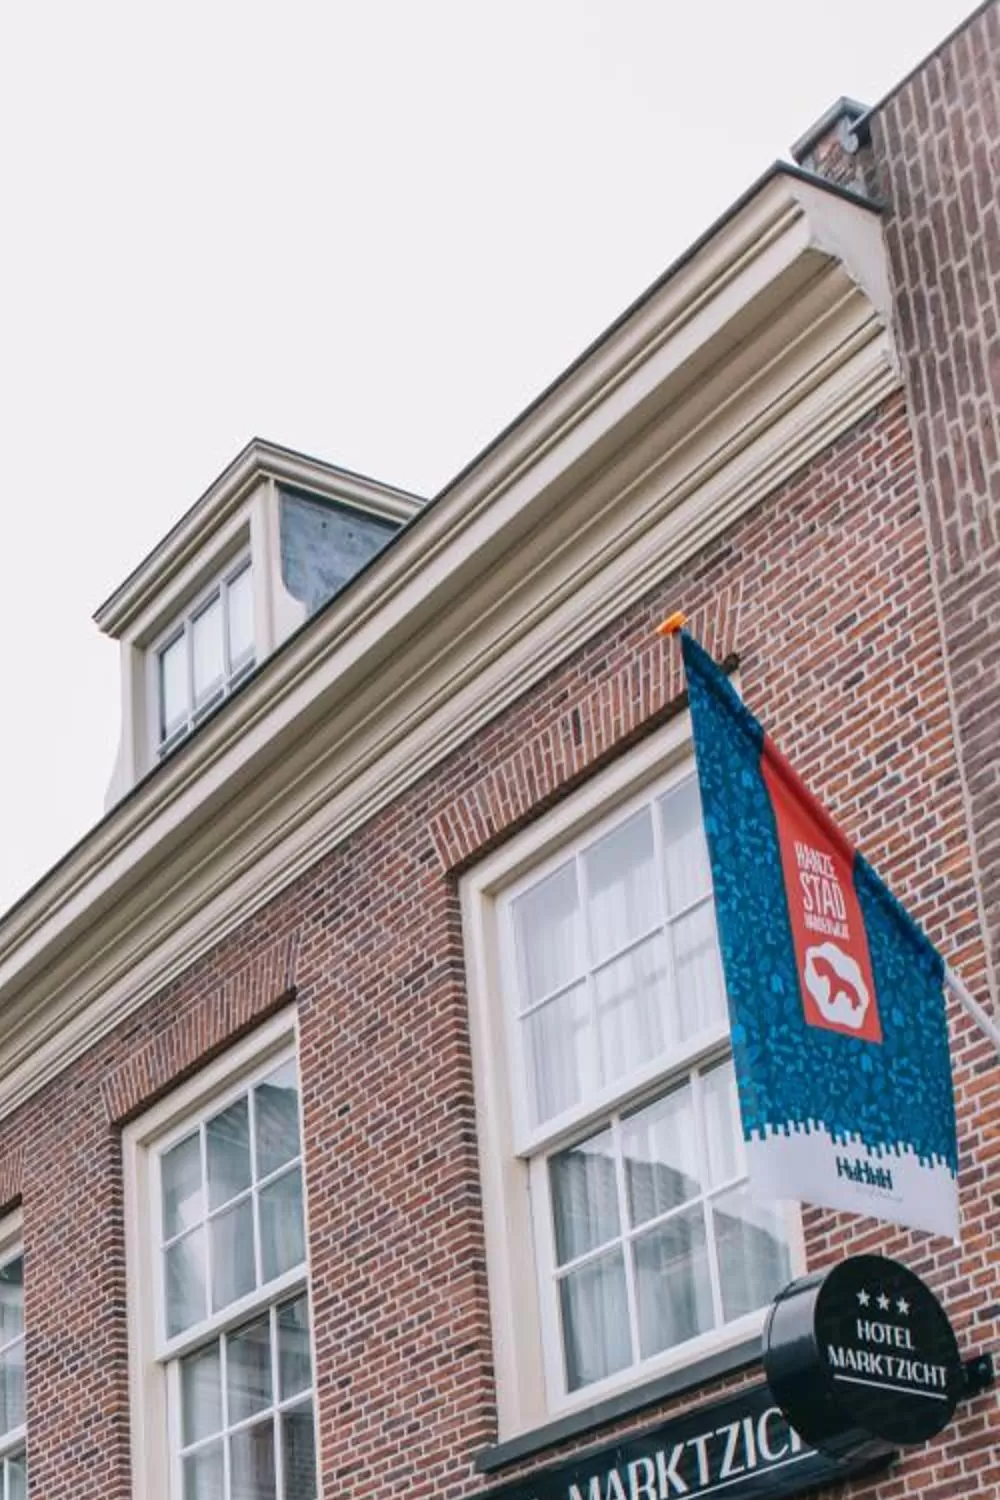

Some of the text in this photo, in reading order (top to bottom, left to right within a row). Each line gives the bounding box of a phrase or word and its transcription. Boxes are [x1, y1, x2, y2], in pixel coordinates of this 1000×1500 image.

[800, 872, 847, 920] STAD
[856, 1318, 915, 1350] HOTEL
[827, 1344, 947, 1388] MARKTZICHT
